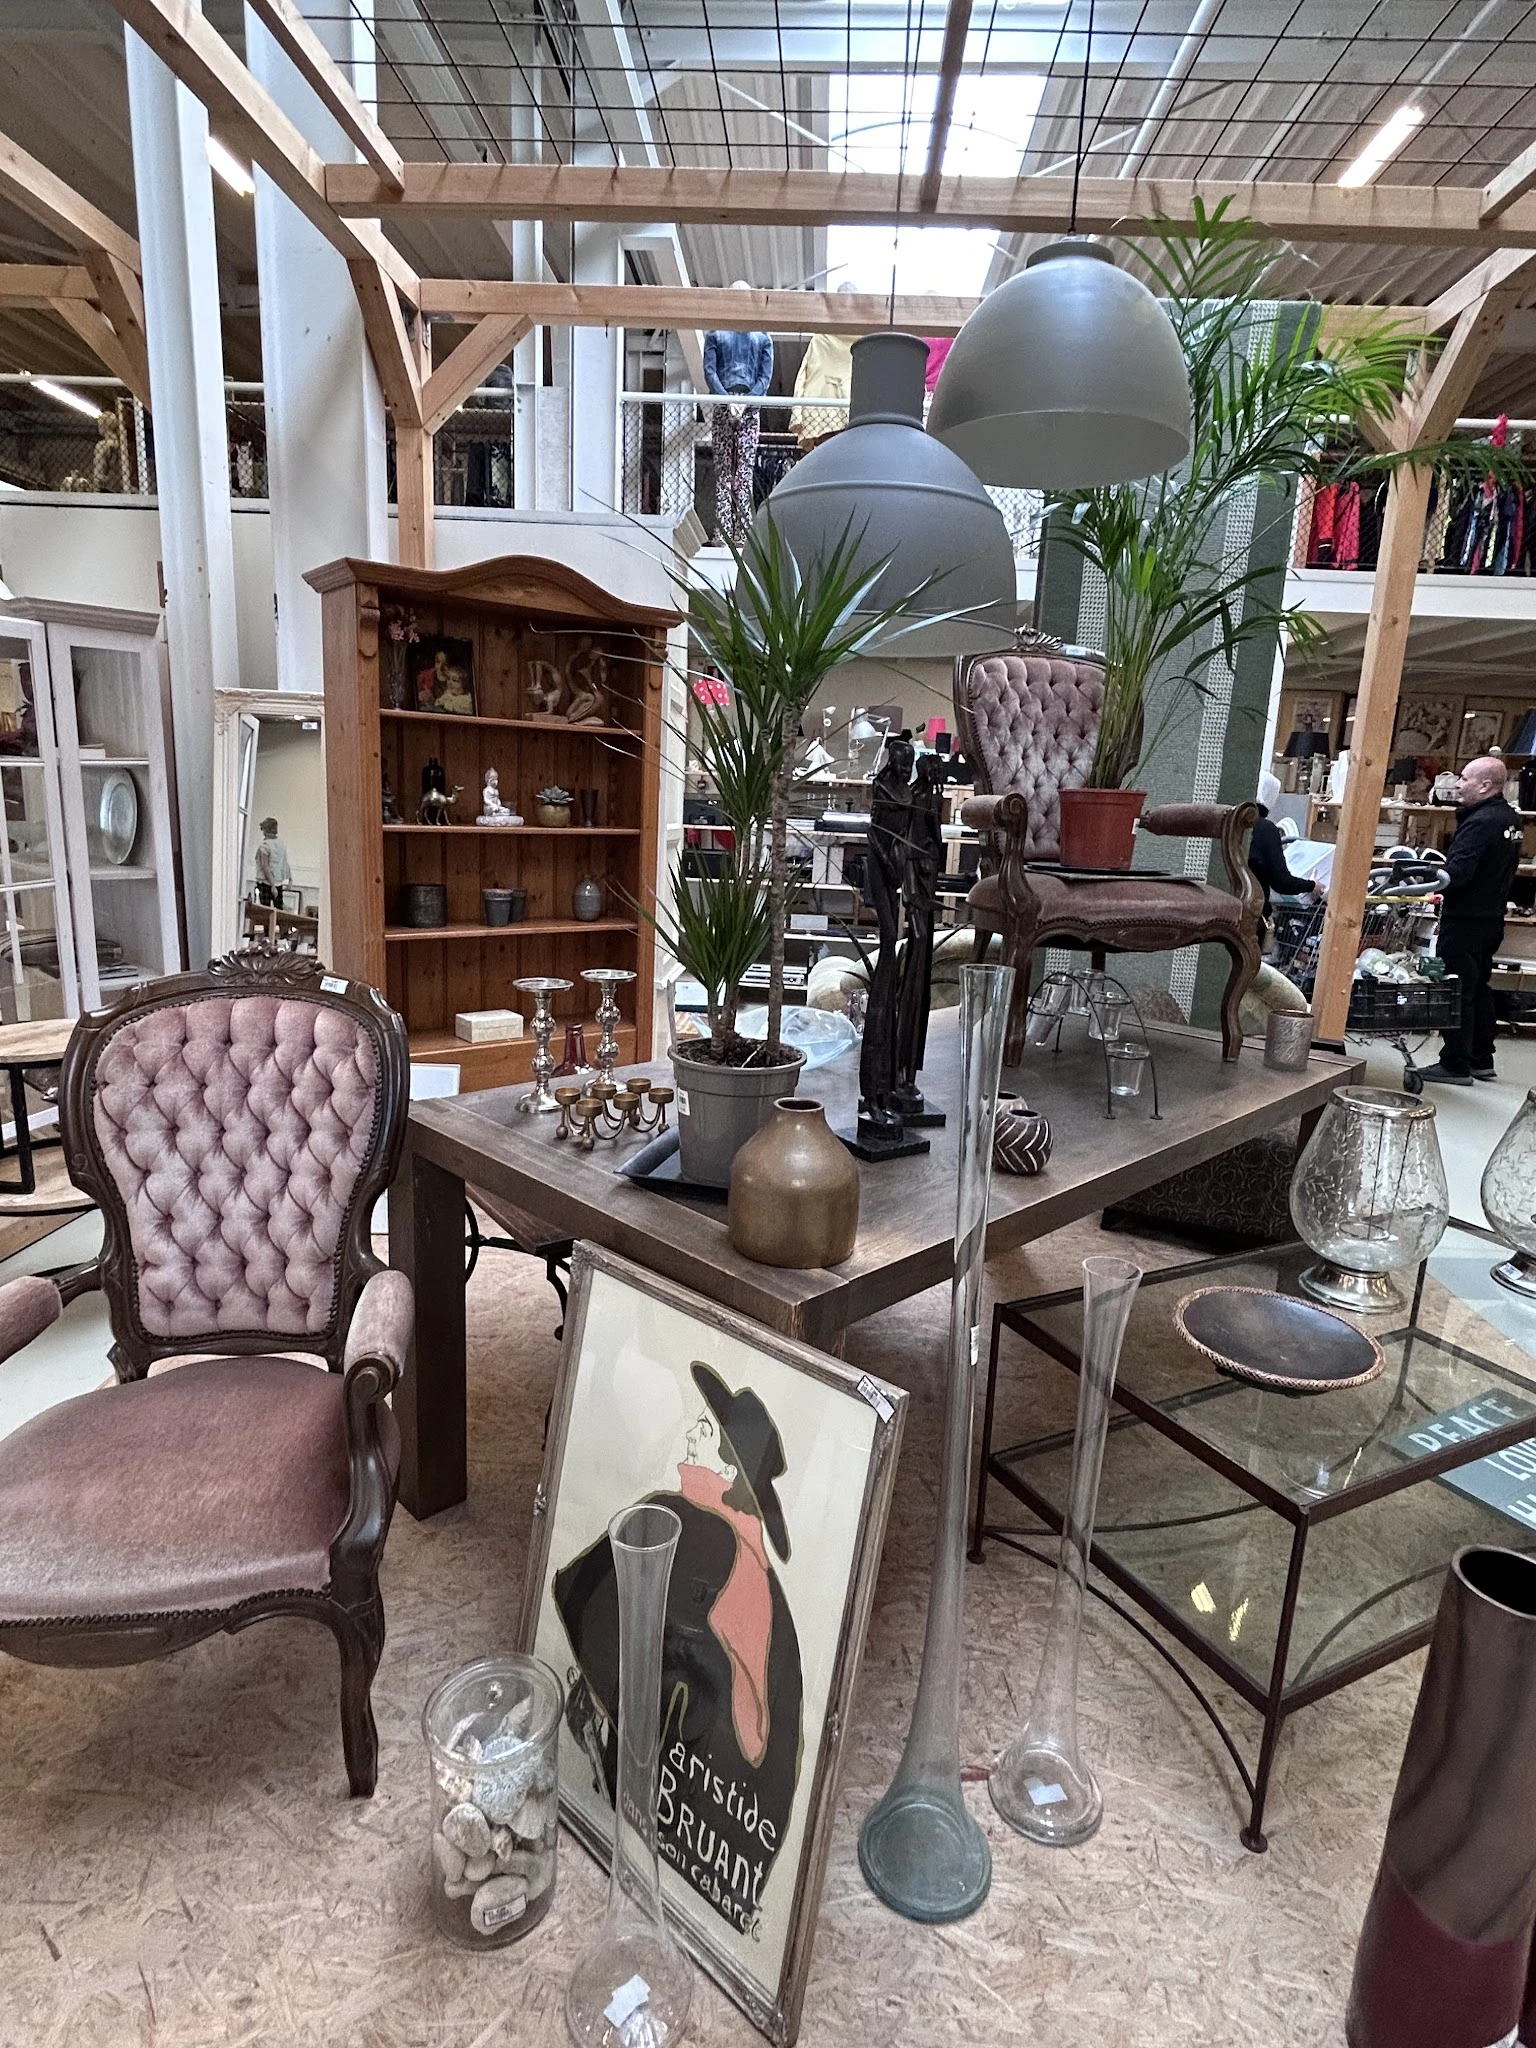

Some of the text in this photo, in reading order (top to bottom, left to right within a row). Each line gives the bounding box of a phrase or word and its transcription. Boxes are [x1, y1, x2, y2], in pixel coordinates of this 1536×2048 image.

[1407, 1397, 1524, 1452] PEACE
[657, 1831, 687, 1870] son
[690, 1864, 763, 1943] cabaret
